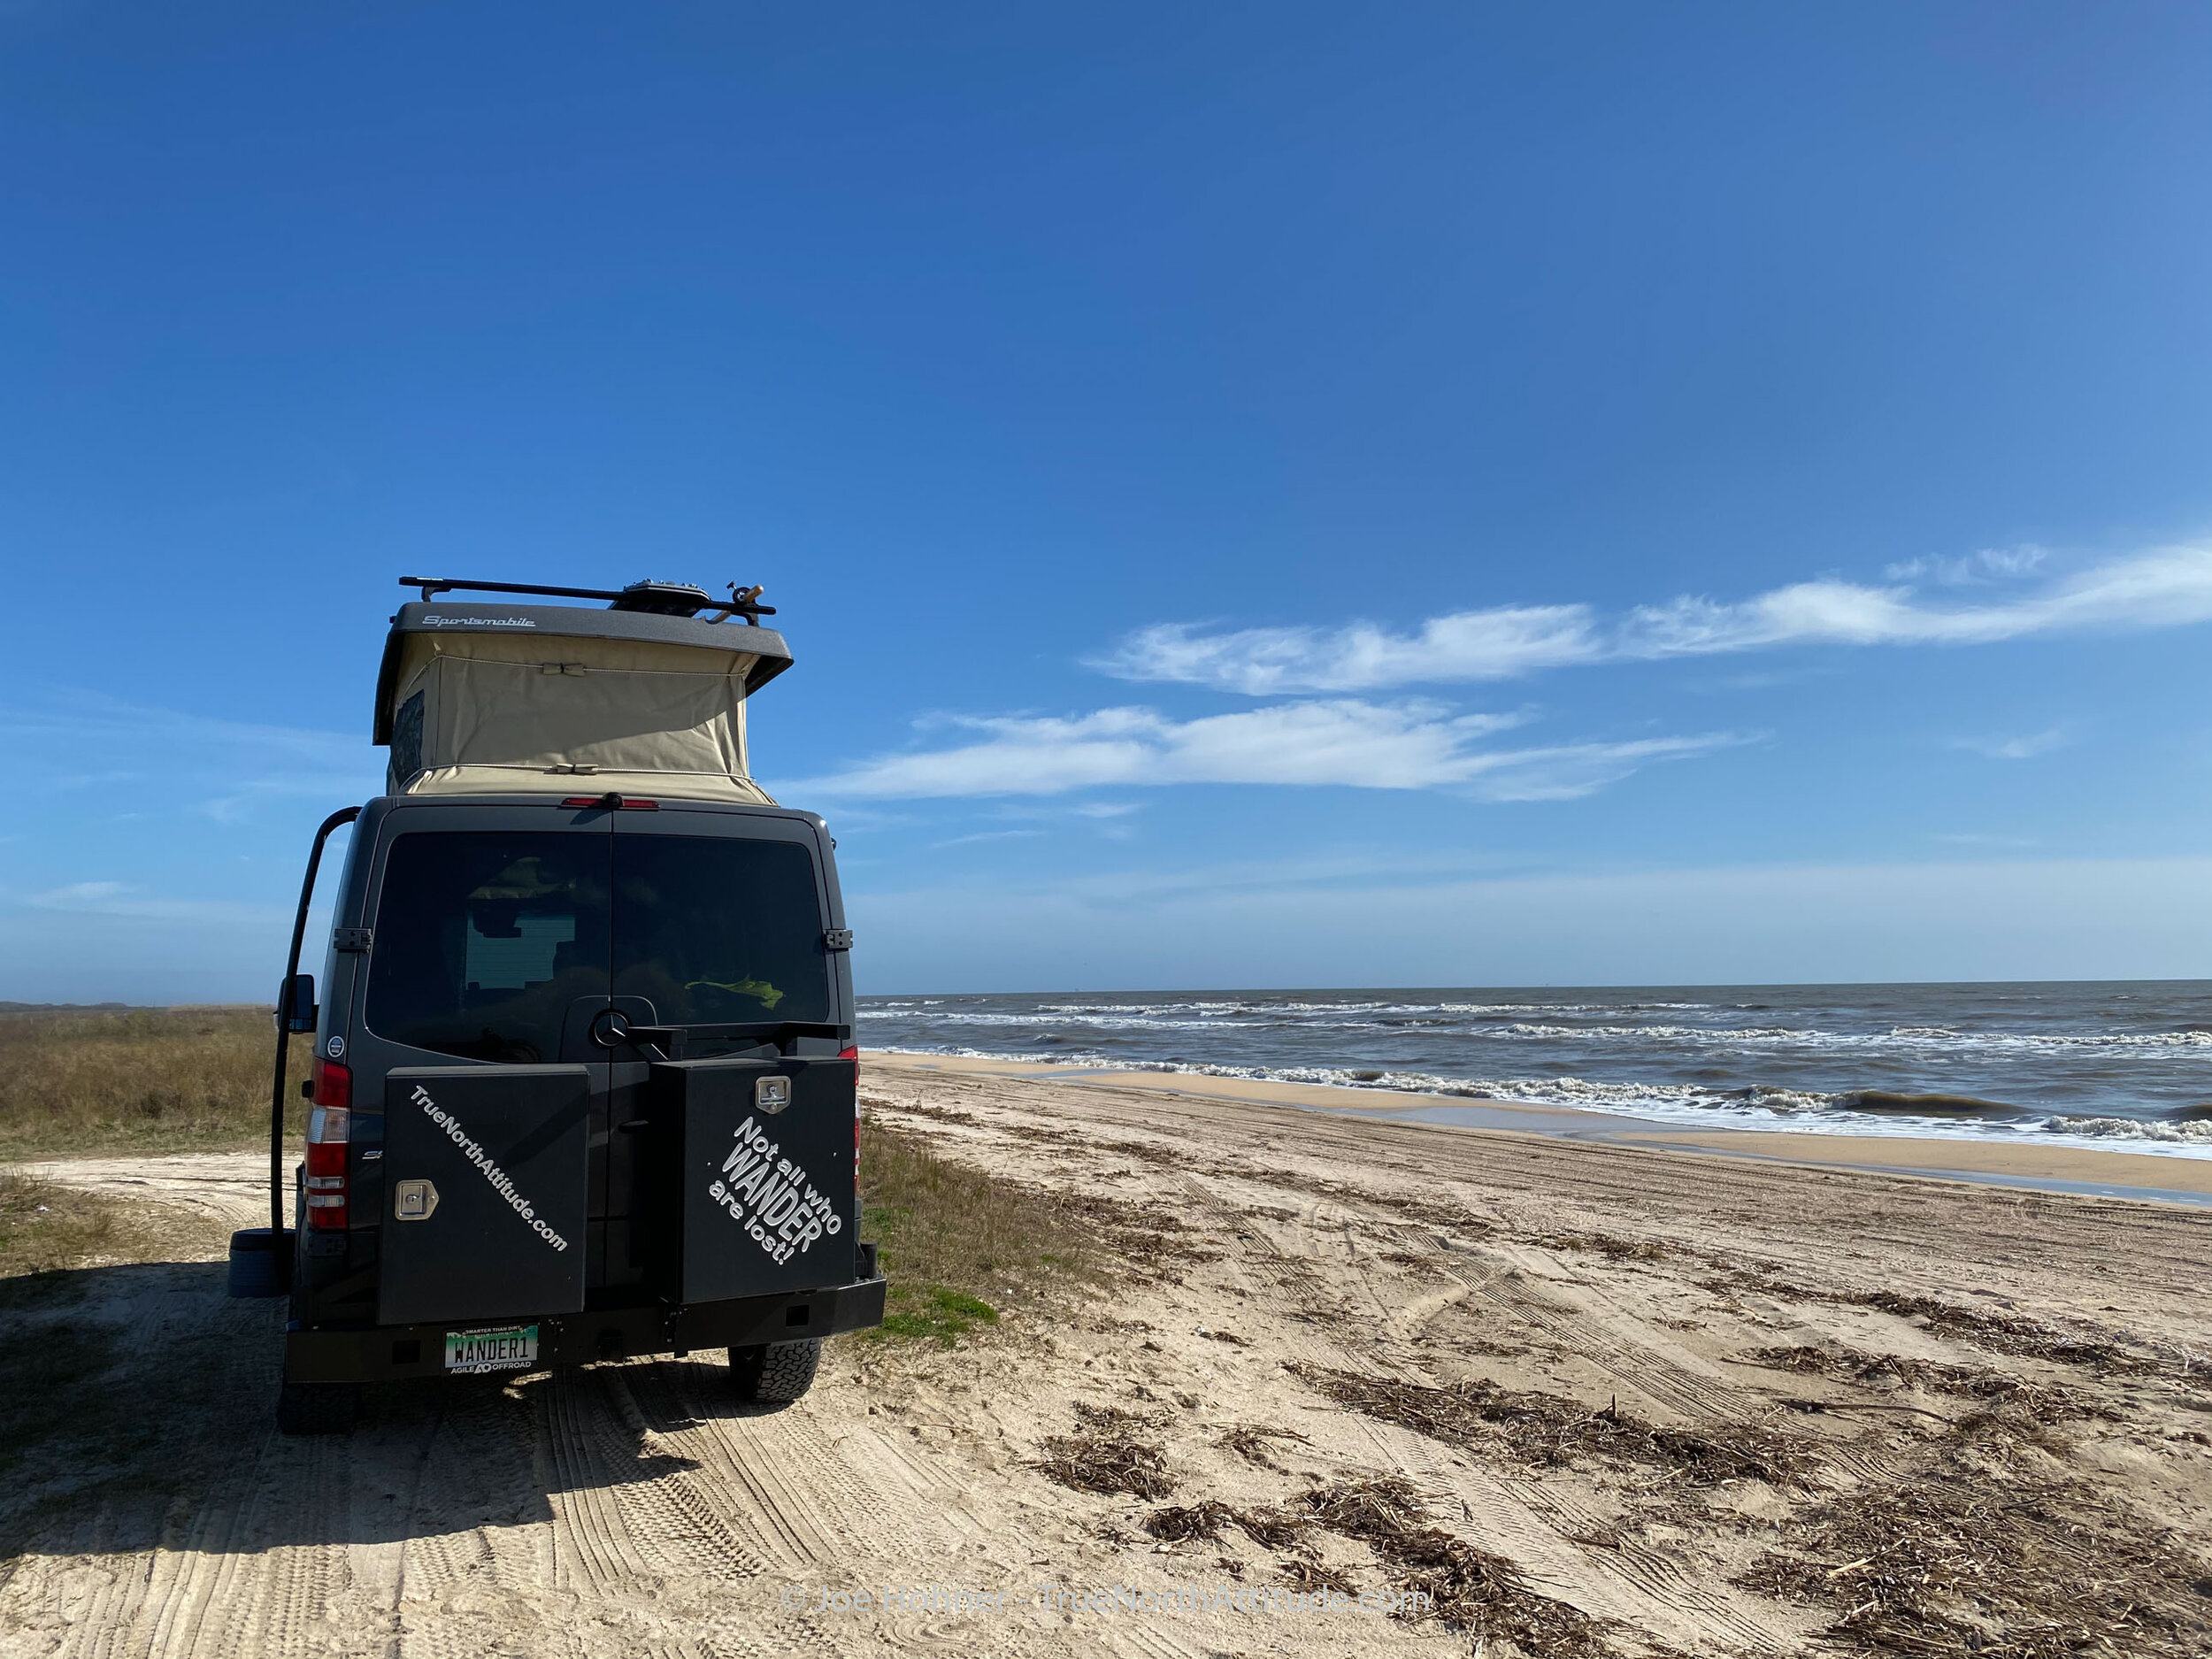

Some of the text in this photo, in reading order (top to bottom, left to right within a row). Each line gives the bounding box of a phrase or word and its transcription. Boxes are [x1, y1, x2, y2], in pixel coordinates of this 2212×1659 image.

[422, 615, 536, 626] Sportsmobile
[410, 1085, 568, 1252] TrueNorthAttitude.com
[722, 1142, 822, 1253] WANDER
[733, 1116, 841, 1234] Not all who
[709, 1179, 795, 1265] are lost!
[450, 1365, 475, 1374] AGILE
[492, 1361, 532, 1371] OFFROAD
[455, 1337, 528, 1363] WANDER1
